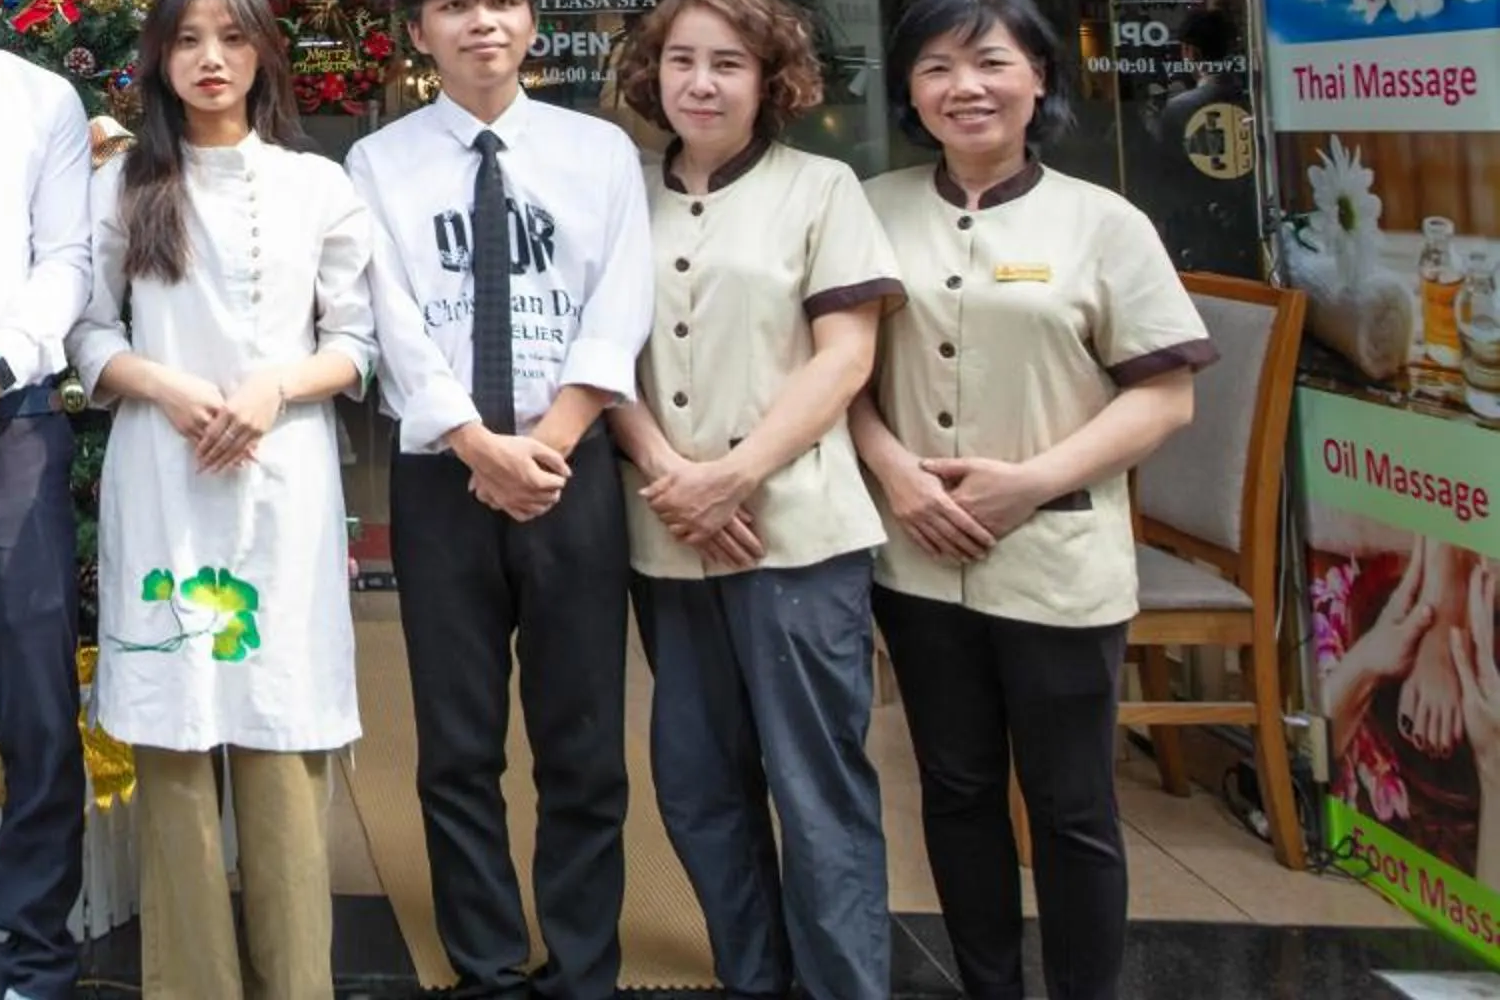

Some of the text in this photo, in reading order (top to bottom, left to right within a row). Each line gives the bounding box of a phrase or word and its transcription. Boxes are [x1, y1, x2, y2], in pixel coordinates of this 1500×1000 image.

[528, 31, 610, 57] OPEN
[1293, 62, 1477, 106] Thai Massage
[434, 198, 555, 274] DOR
[1323, 437, 1490, 522] Oil Massage
[1353, 825, 1411, 893] Foot
